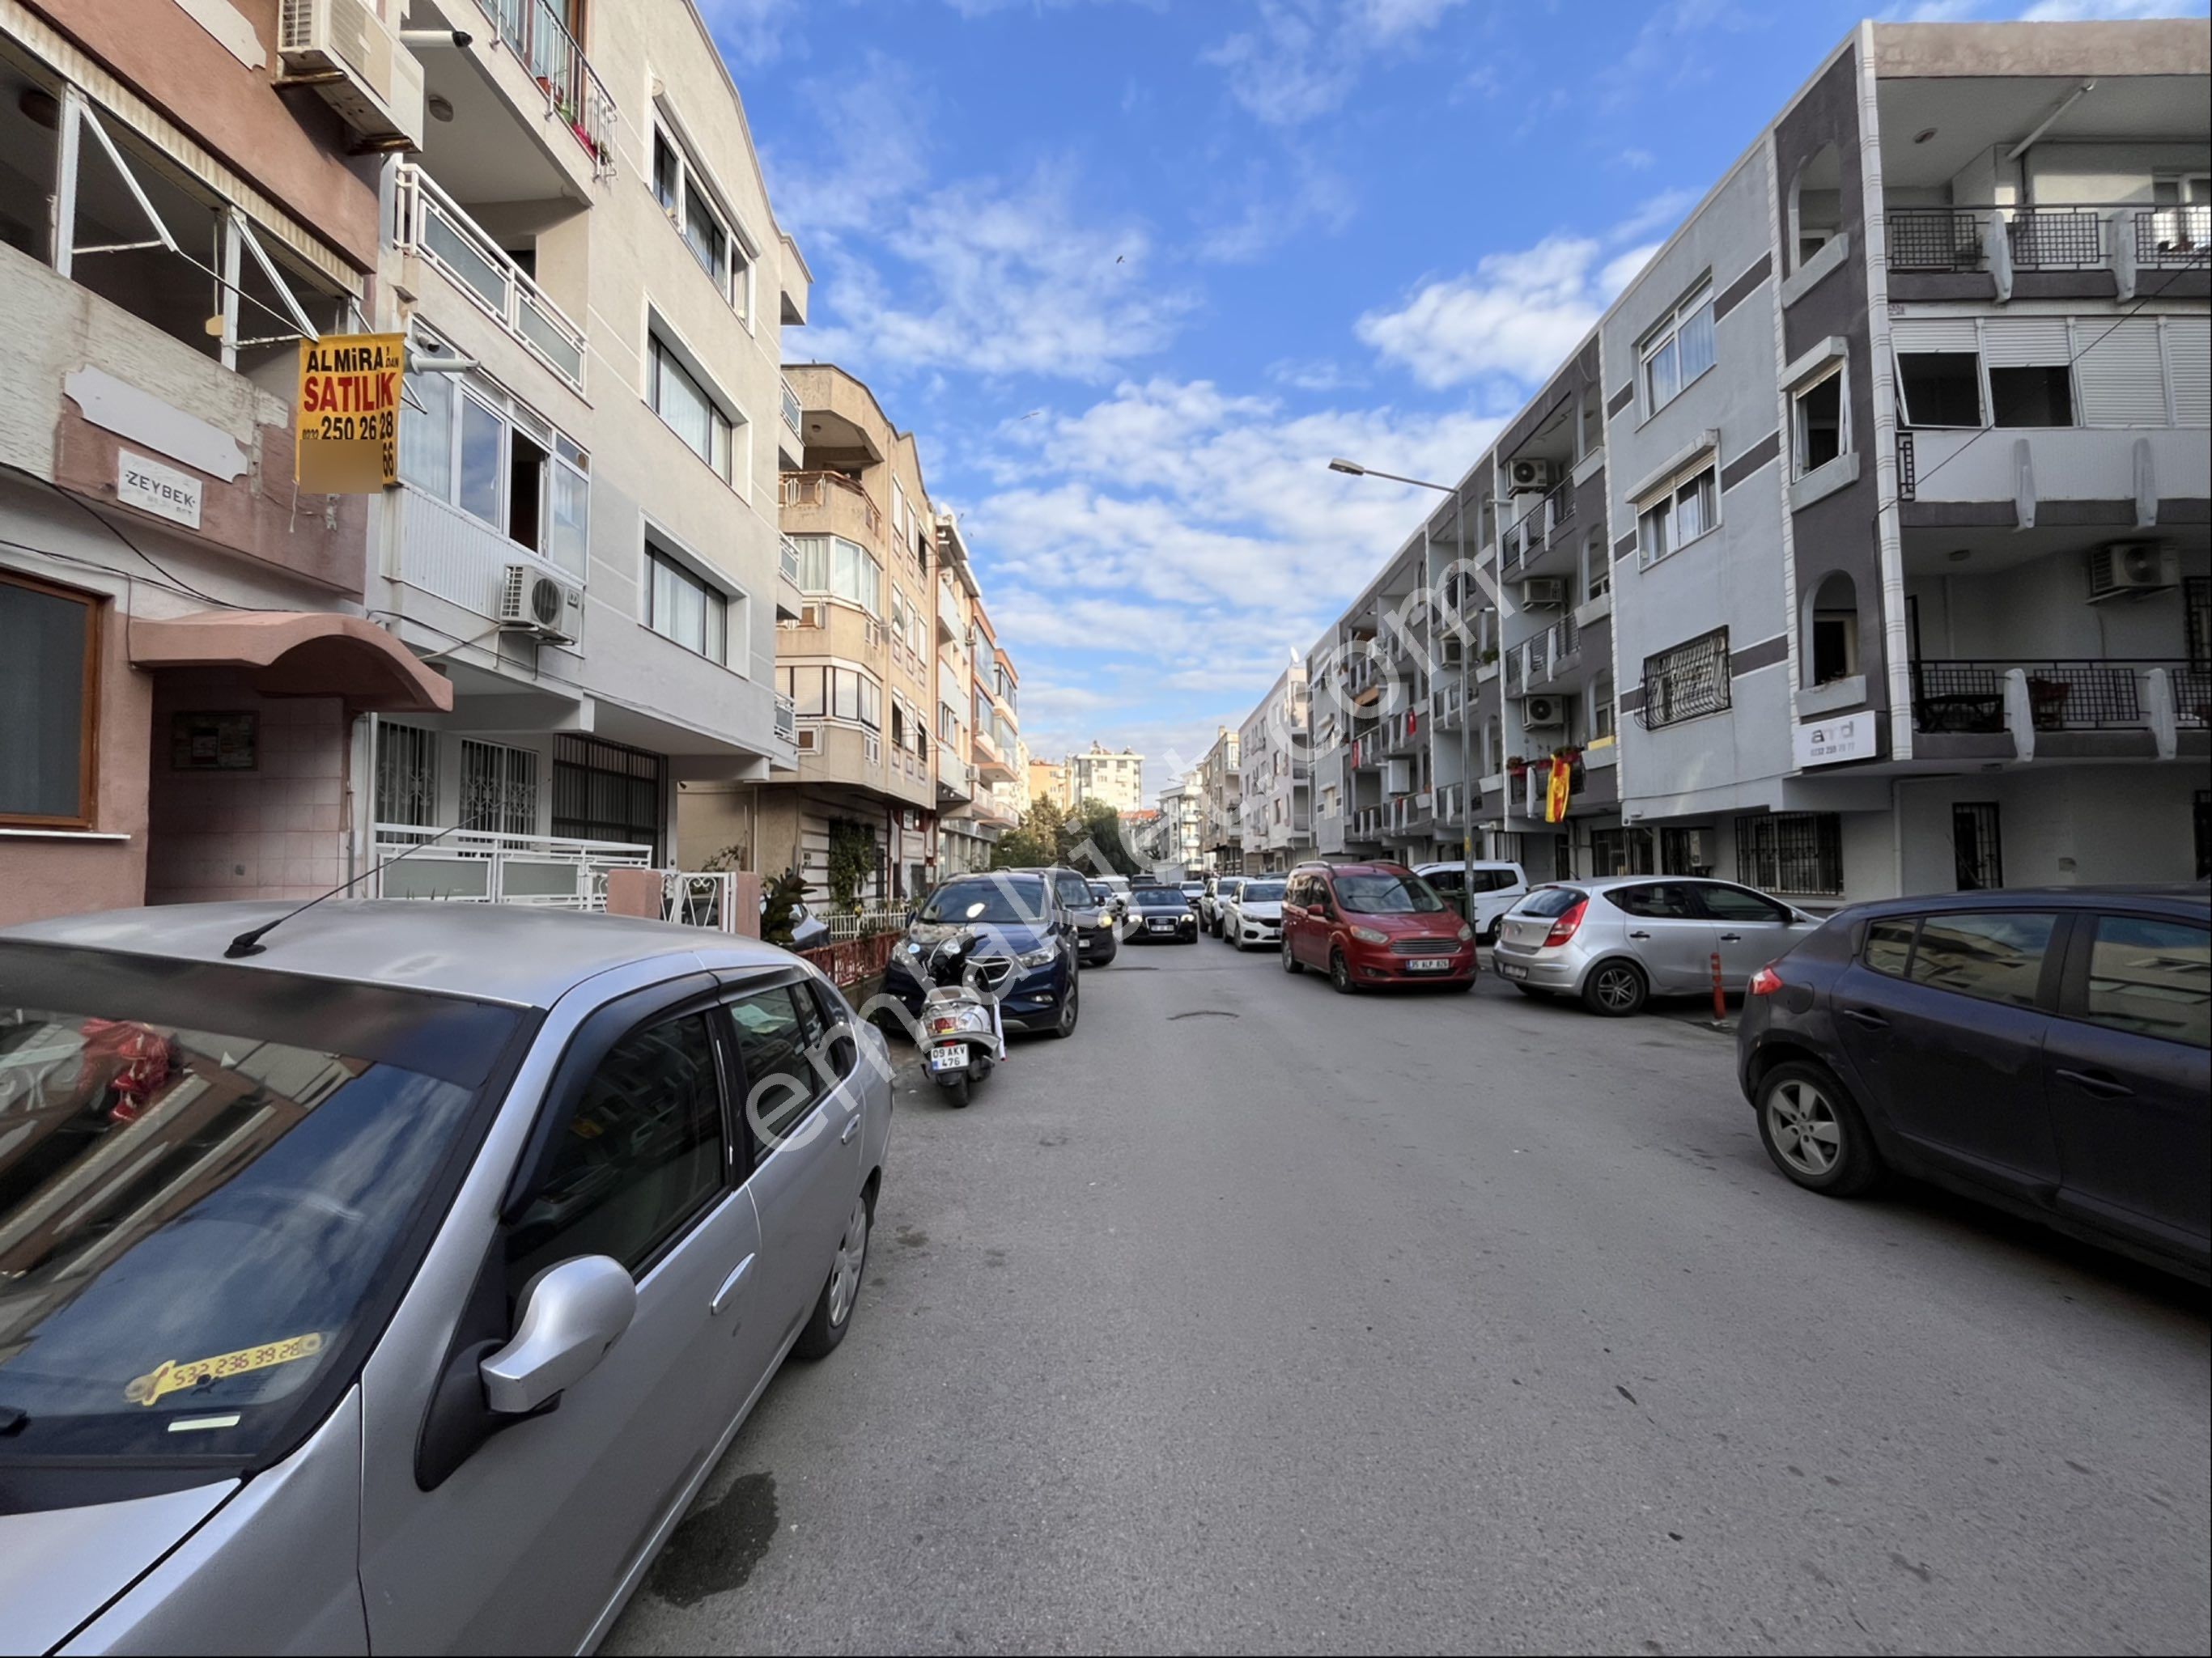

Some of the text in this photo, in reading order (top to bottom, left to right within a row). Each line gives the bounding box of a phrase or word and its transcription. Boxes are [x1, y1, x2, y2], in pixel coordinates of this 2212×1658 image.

[304, 372, 396, 412] SATILIK
[321, 416, 355, 440] 250
[359, 415, 377, 440] 26
[380, 411, 393, 439] 28
[932, 1046, 965, 1058] 09 AKV
[942, 1058, 960, 1066] 476
